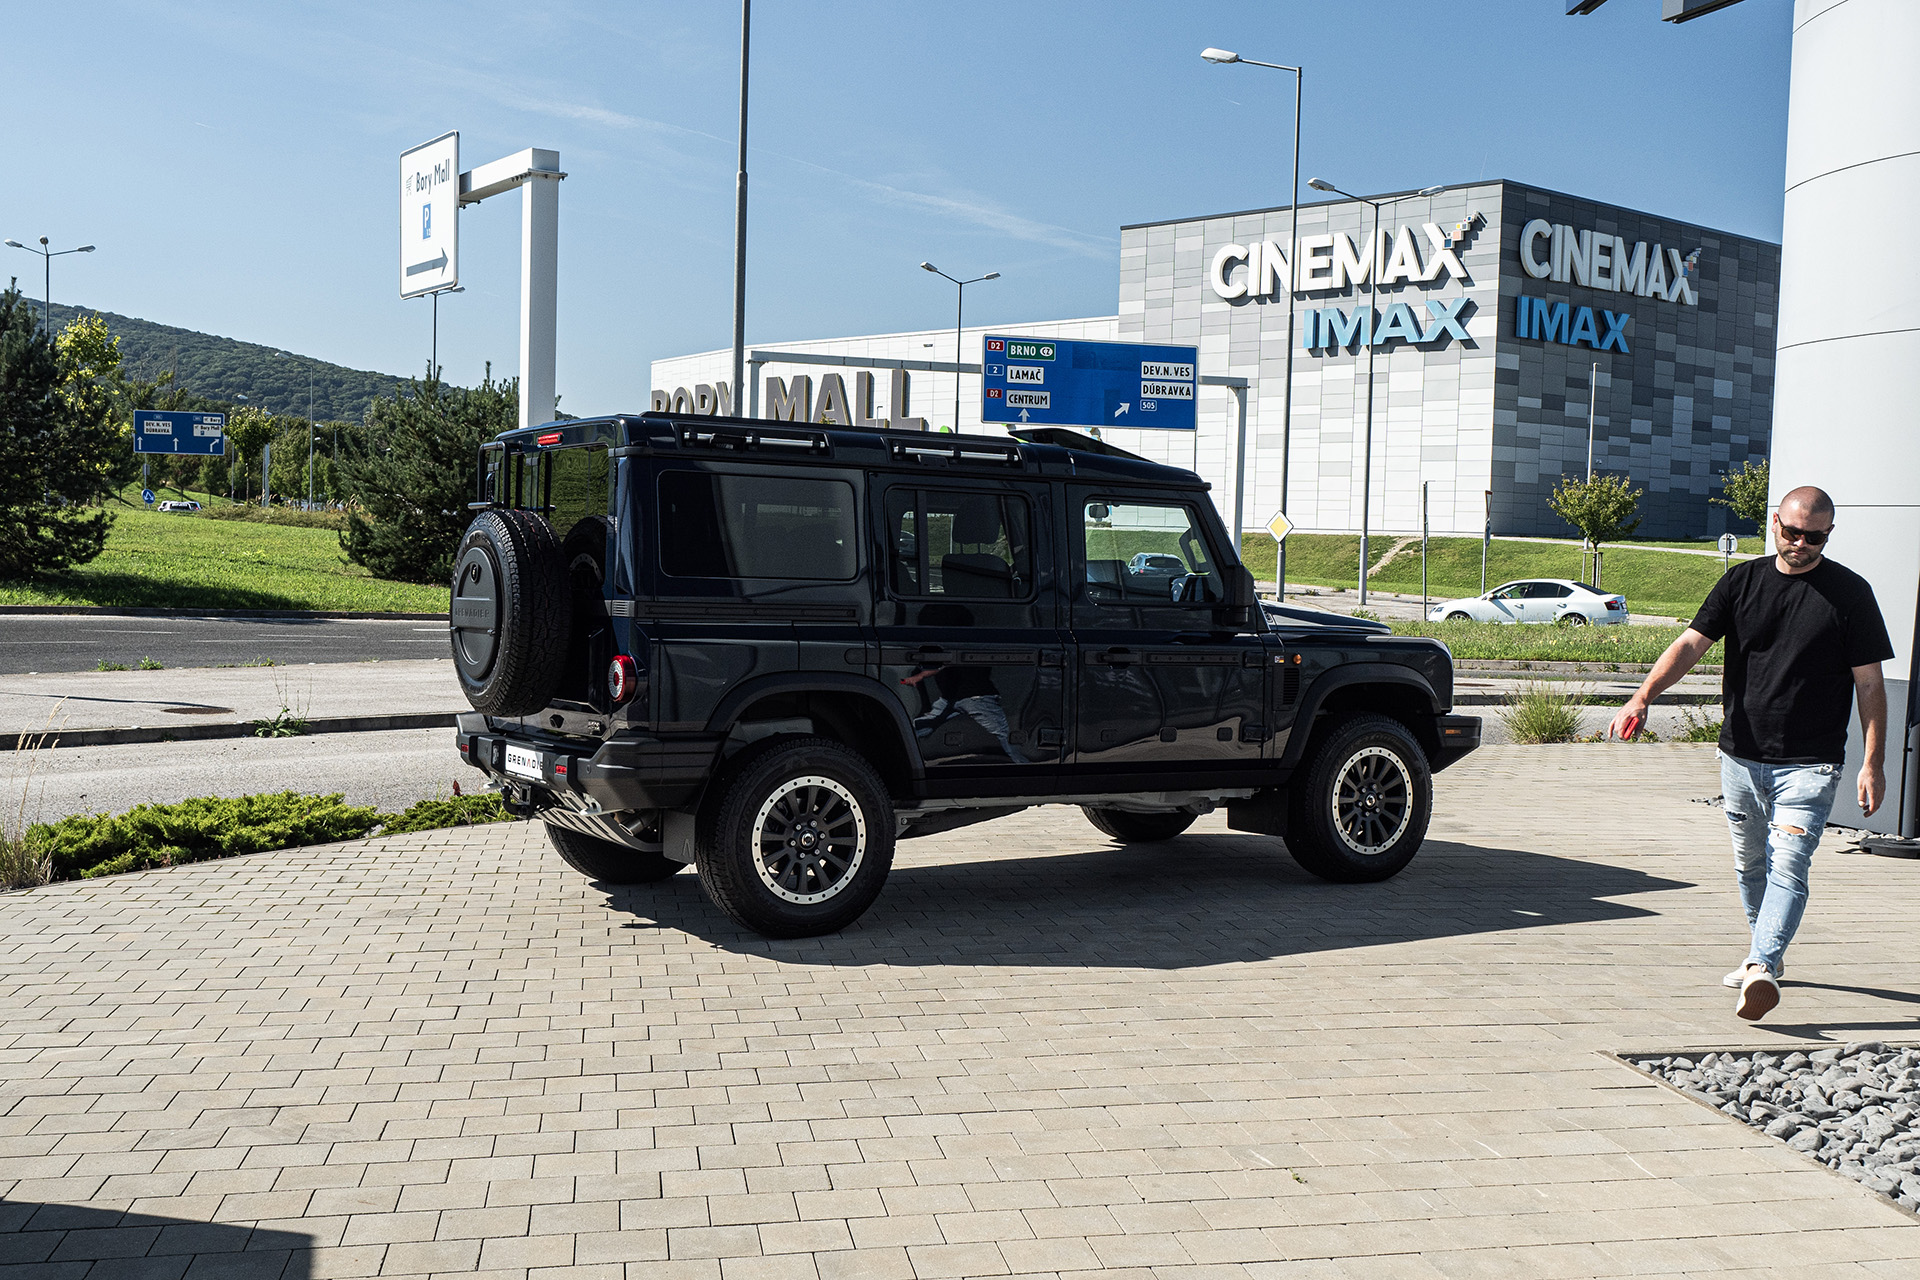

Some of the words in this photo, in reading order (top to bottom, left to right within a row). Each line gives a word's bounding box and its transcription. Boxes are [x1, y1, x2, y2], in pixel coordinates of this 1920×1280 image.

[416, 172, 432, 195] Bory
[434, 158, 450, 186] Mall
[1210, 214, 1480, 299] CINEMAX
[1520, 219, 1699, 306] CINEMAX
[1303, 298, 1472, 349] IMAX
[1516, 295, 1631, 354] IMAX
[990, 342, 1001, 350] D2
[1010, 345, 1037, 356] BRNO
[1041, 347, 1051, 356] CZ
[993, 366, 998, 374] 2
[1010, 368, 1041, 381] LAMAČ
[989, 390, 999, 398] D2
[1143, 383, 1191, 397] DÚBRAVKA
[765, 369, 926, 432] MALL
[1008, 394, 1048, 406] CENTRUM
[508, 753, 544, 770] GRENADIE
